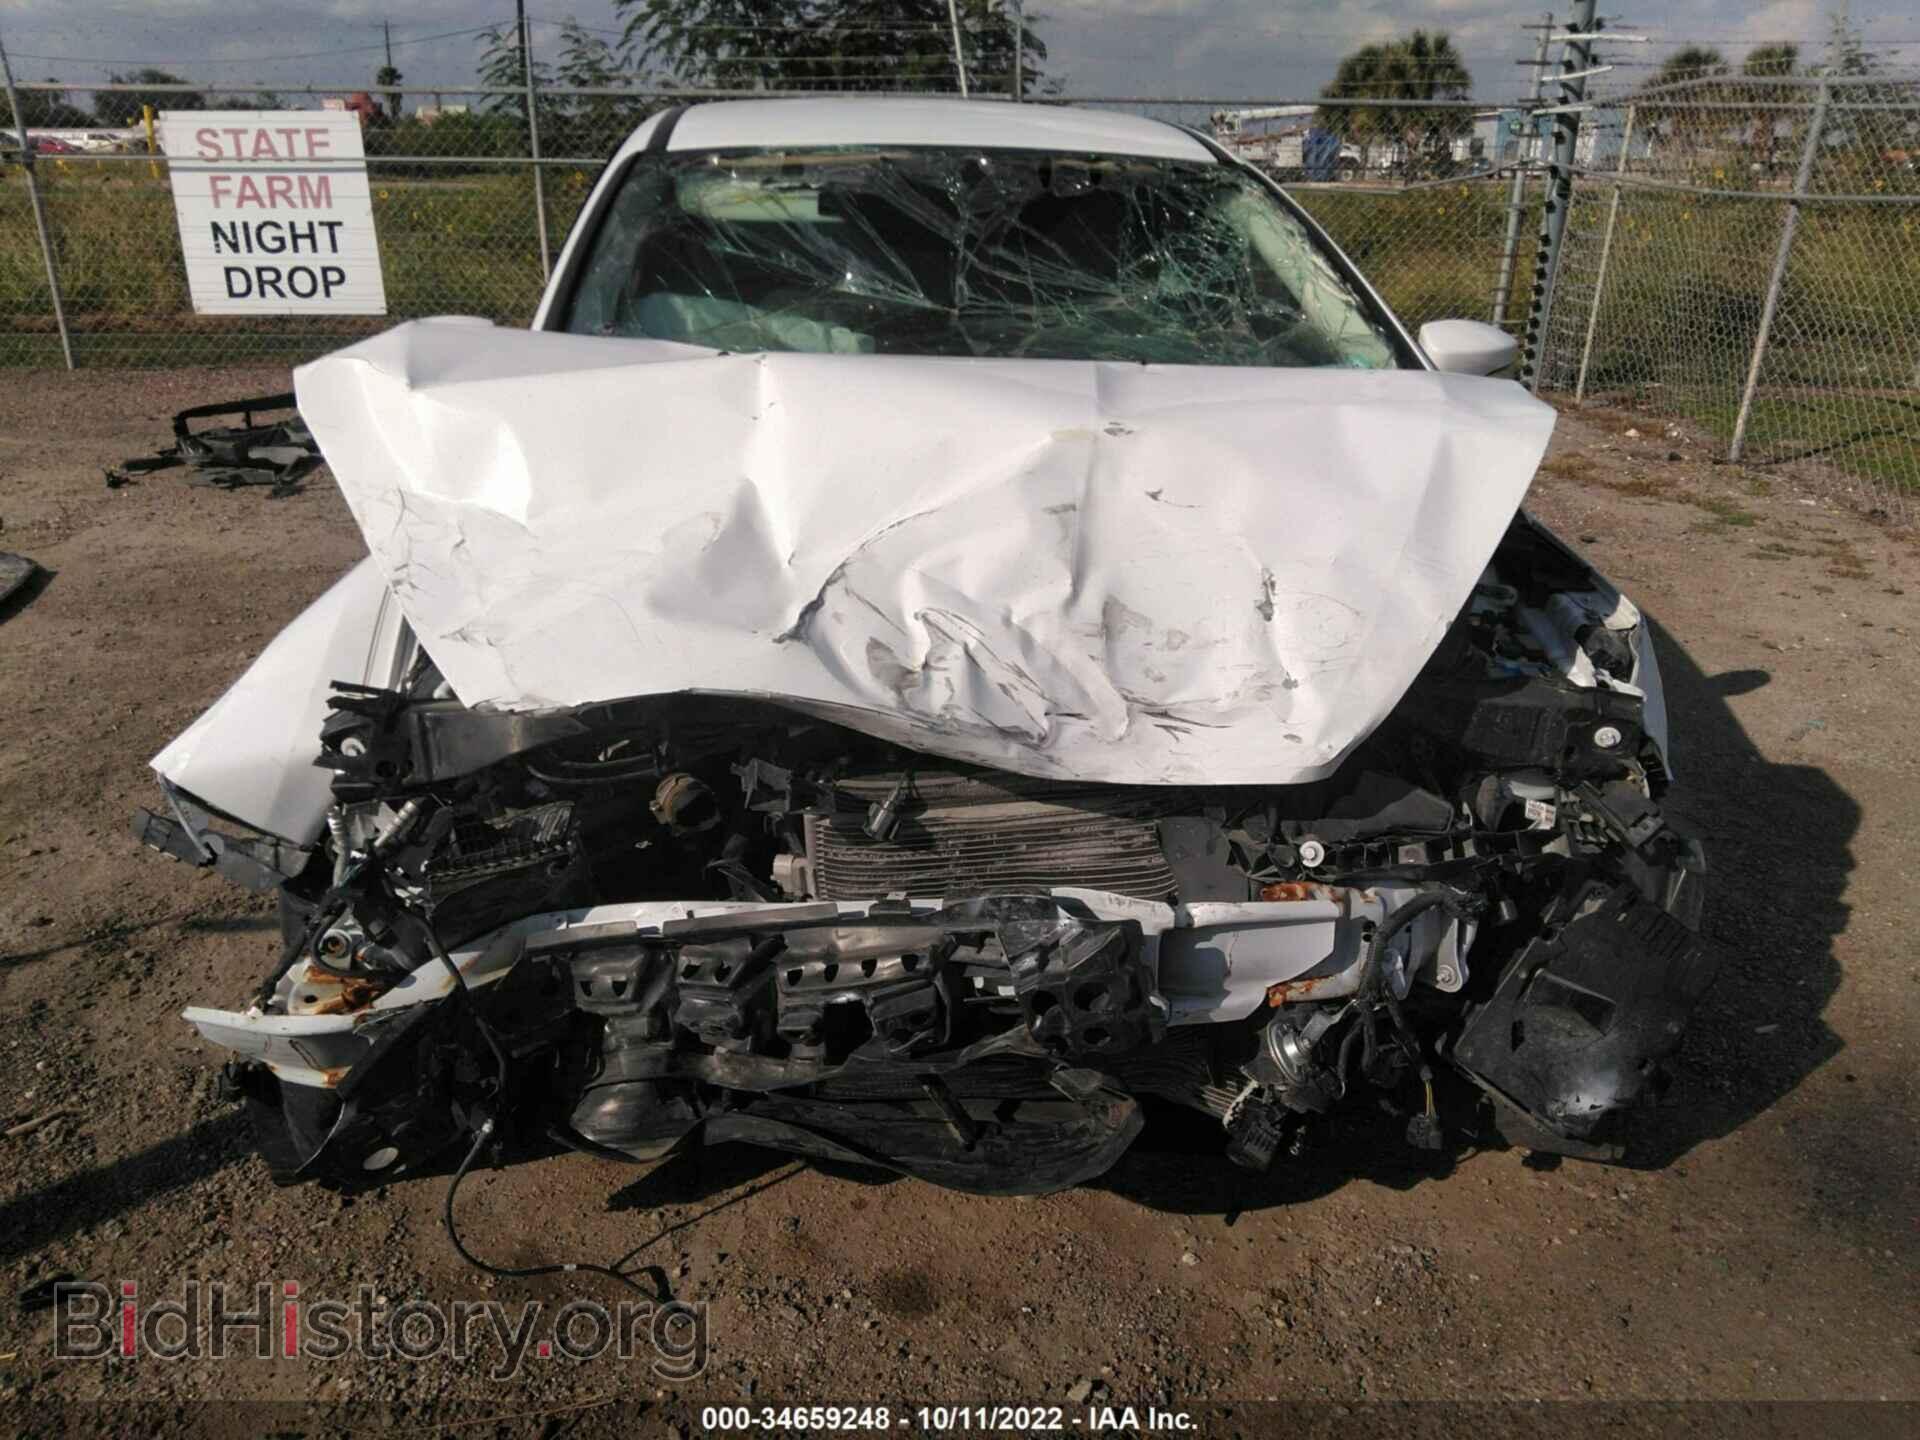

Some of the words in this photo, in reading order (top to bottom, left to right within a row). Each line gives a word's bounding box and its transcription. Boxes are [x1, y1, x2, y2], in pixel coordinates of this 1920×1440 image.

[195, 128, 334, 162] STATE
[209, 175, 333, 209] FARM
[210, 221, 343, 254] NIGHT
[224, 266, 346, 299] DROP
